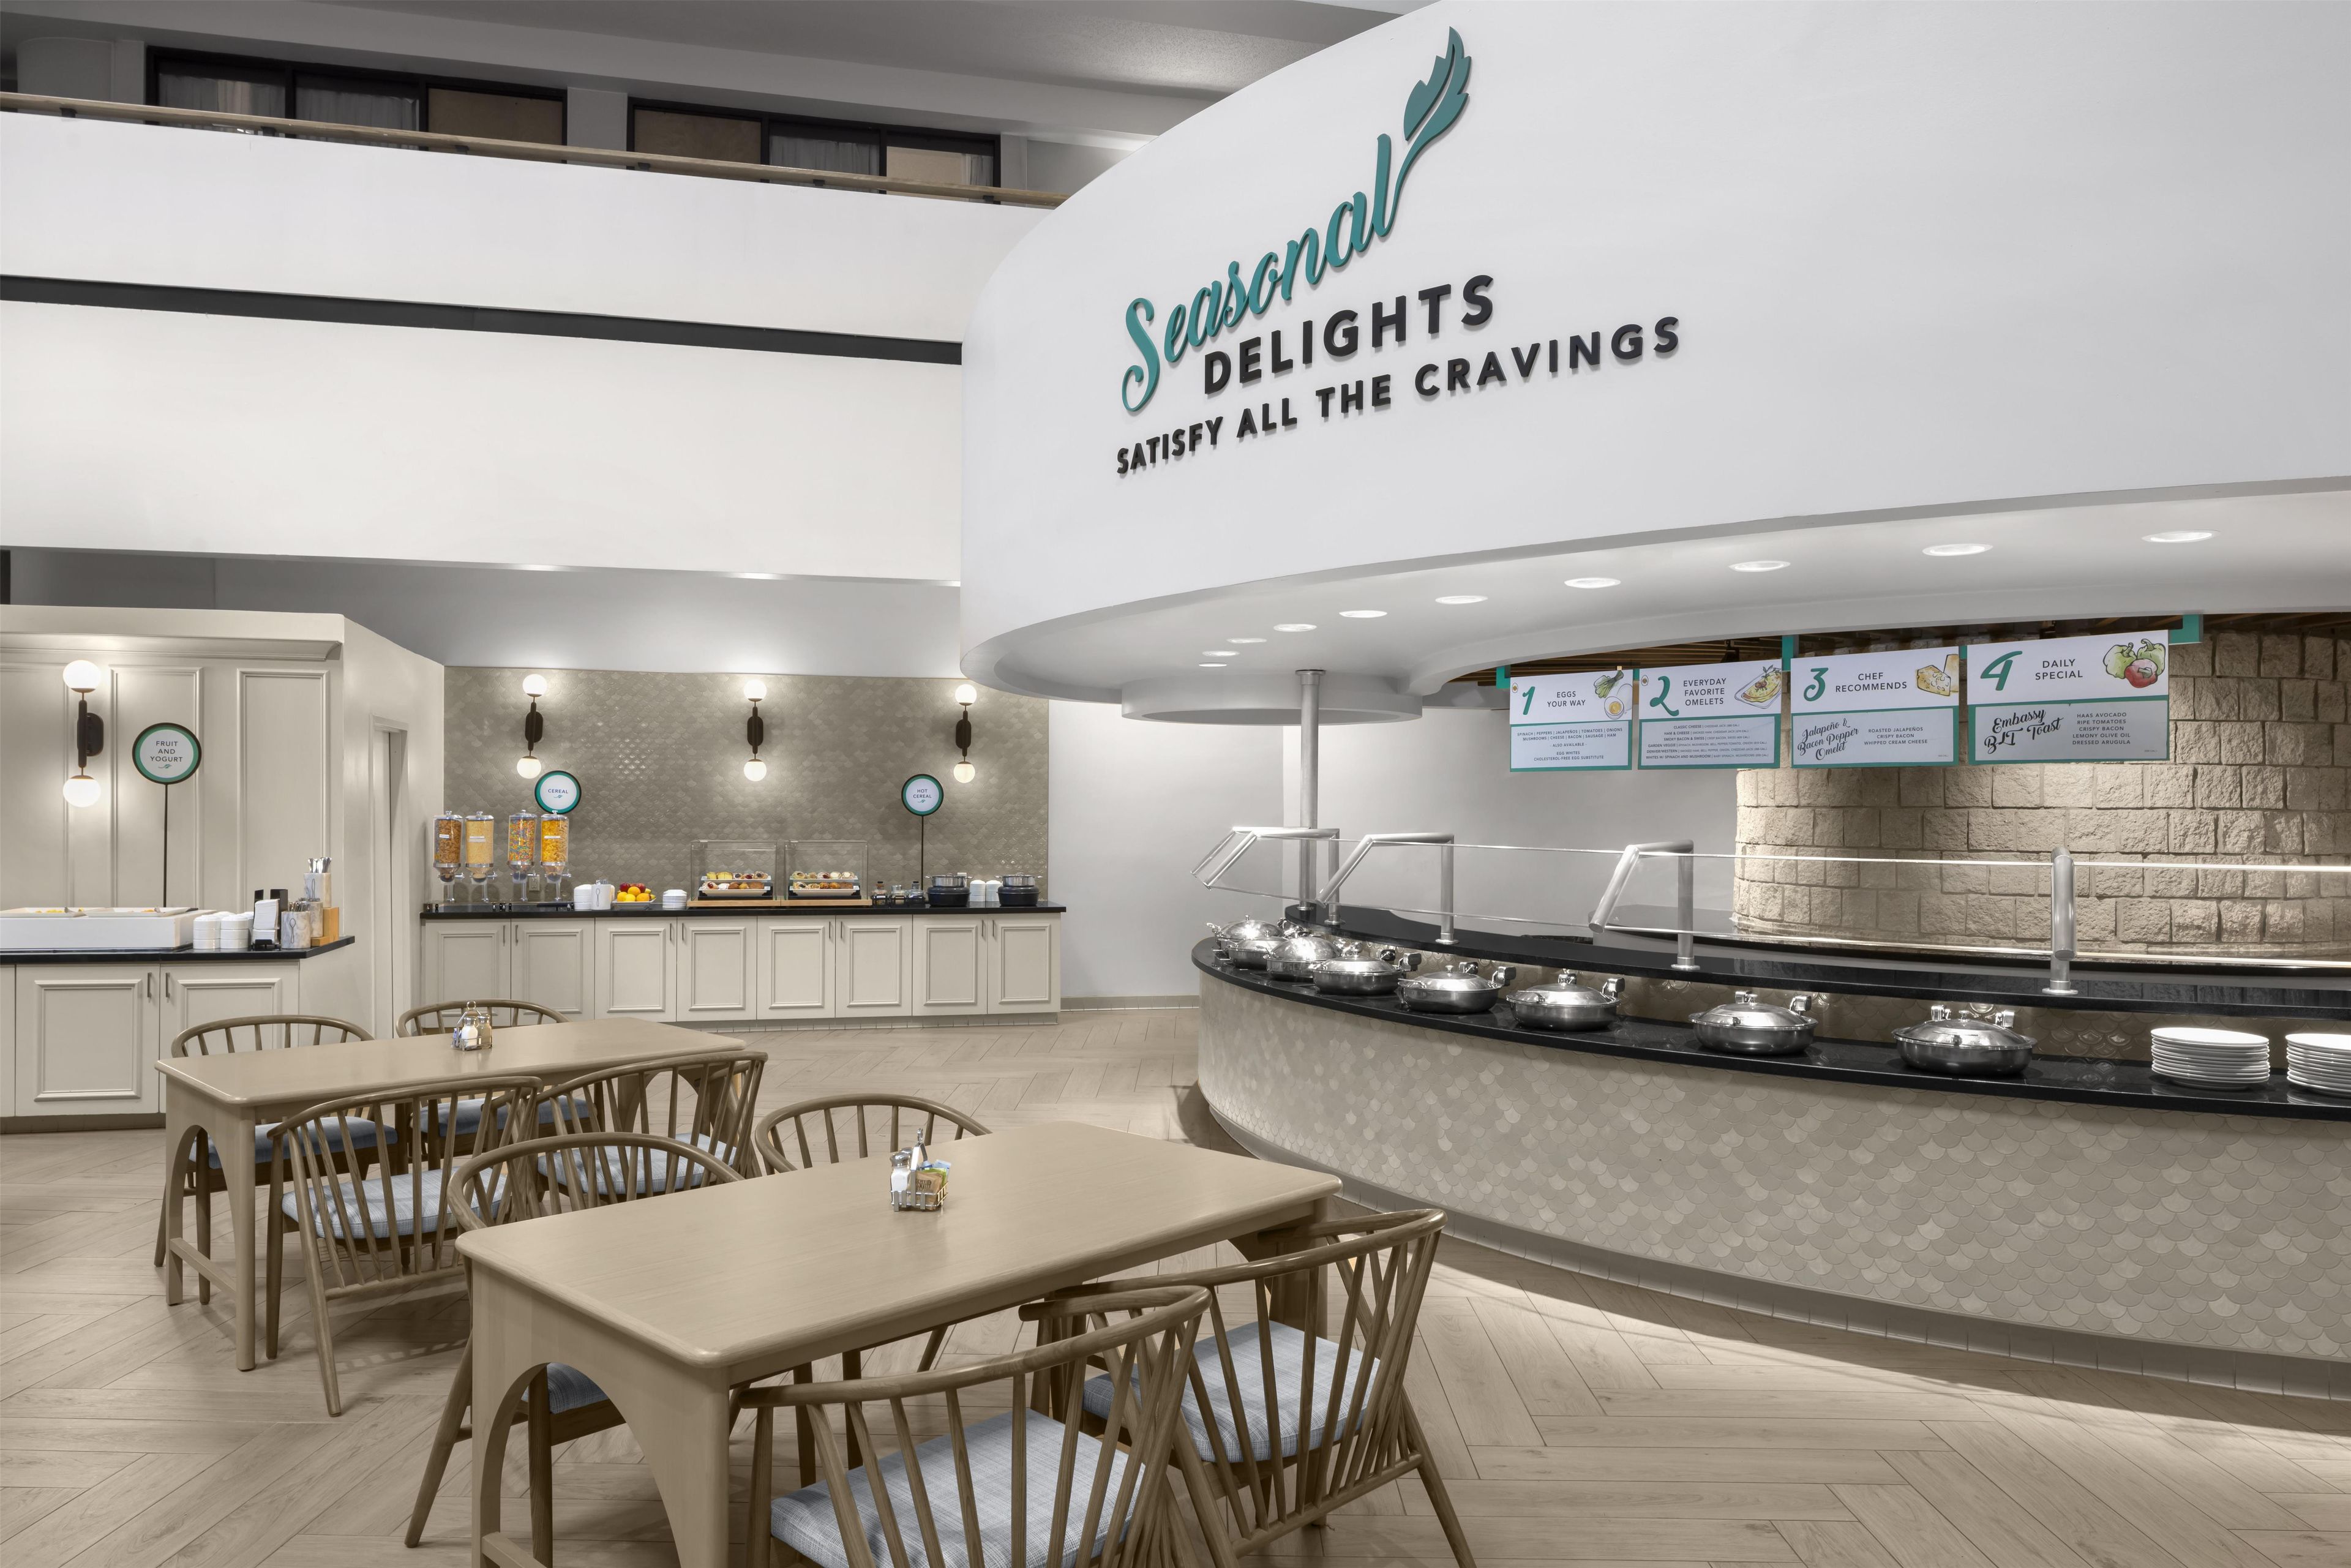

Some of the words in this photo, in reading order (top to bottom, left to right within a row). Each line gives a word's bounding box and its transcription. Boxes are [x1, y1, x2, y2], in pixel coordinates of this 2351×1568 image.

[1122, 132, 1406, 413] Seasonal
[1204, 274, 1494, 395] DELIGHTS
[1116, 416, 1223, 475] SATISFY
[1237, 397, 1297, 439] ALL
[1316, 374, 1391, 418] THE
[1415, 316, 1679, 397] CRAVINGS
[1858, 672, 1883, 681] CHEF
[1980, 650, 2023, 691] 4
[2035, 670, 2083, 680] SPECIAL
[2042, 659, 2075, 668] DAILY
[1683, 678, 1727, 687] EVERYDAY
[1684, 688, 1725, 696] FAVORITE
[1804, 667, 1829, 702] 3
[1835, 681, 1907, 692] RECOMMENDS
[1522, 686, 1535, 715] 1
[1649, 676, 1679, 716] 2
[1802, 722, 1840, 743] Jalapeño
[1843, 718, 1851, 728] &
[1992, 710, 2046, 733] Embassy
[1798, 739, 1824, 756] Bacon
[1826, 728, 1859, 745] Popper
[1984, 727, 2023, 754] BLT
[2027, 717, 2064, 740] Toast
[1815, 741, 1848, 760] Omelet
